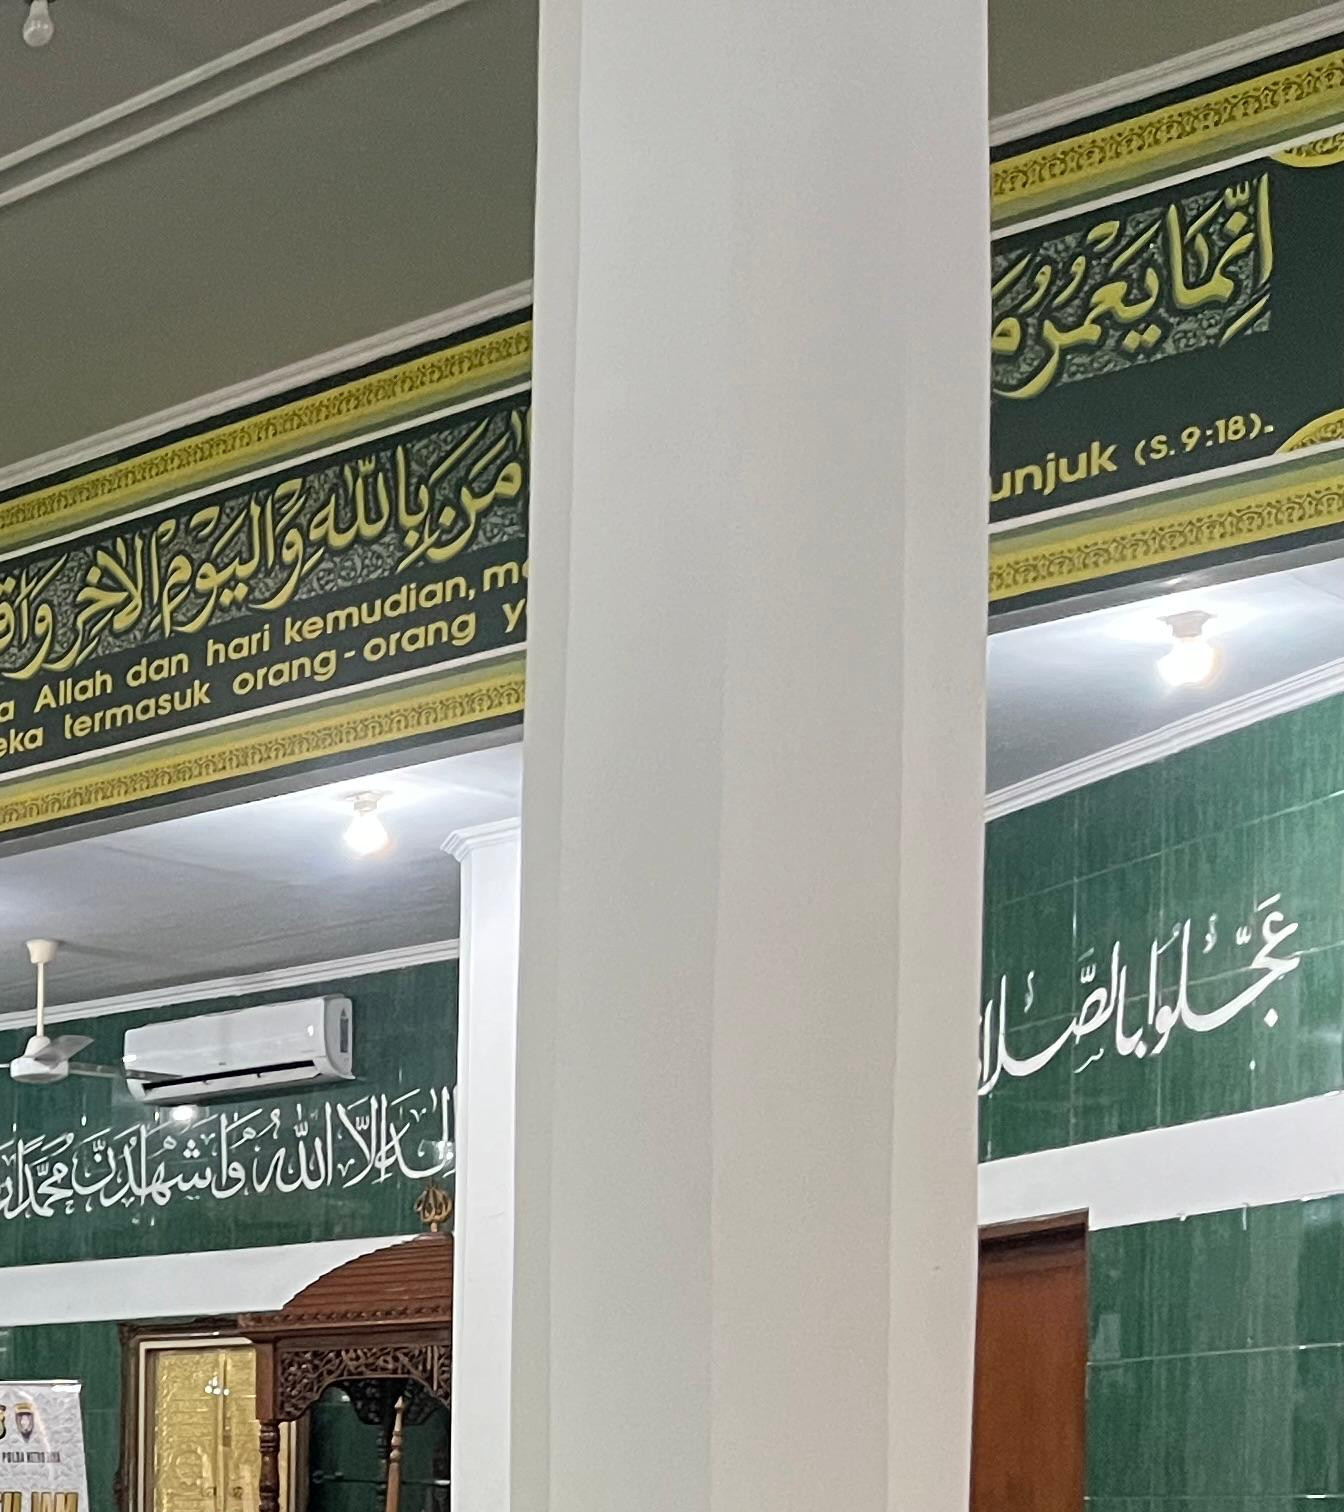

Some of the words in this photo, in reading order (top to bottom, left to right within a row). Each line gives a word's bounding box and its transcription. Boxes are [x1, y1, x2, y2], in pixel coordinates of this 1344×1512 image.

[990, 440, 1119, 503] unjuk
[32, 670, 114, 715] Allah
[125, 649, 189, 690] dan
[205, 623, 271, 668] hari
[284, 572, 477, 648] kemudian,
[62, 678, 211, 740] termasuk
[230, 610, 478, 697] orang-orang
